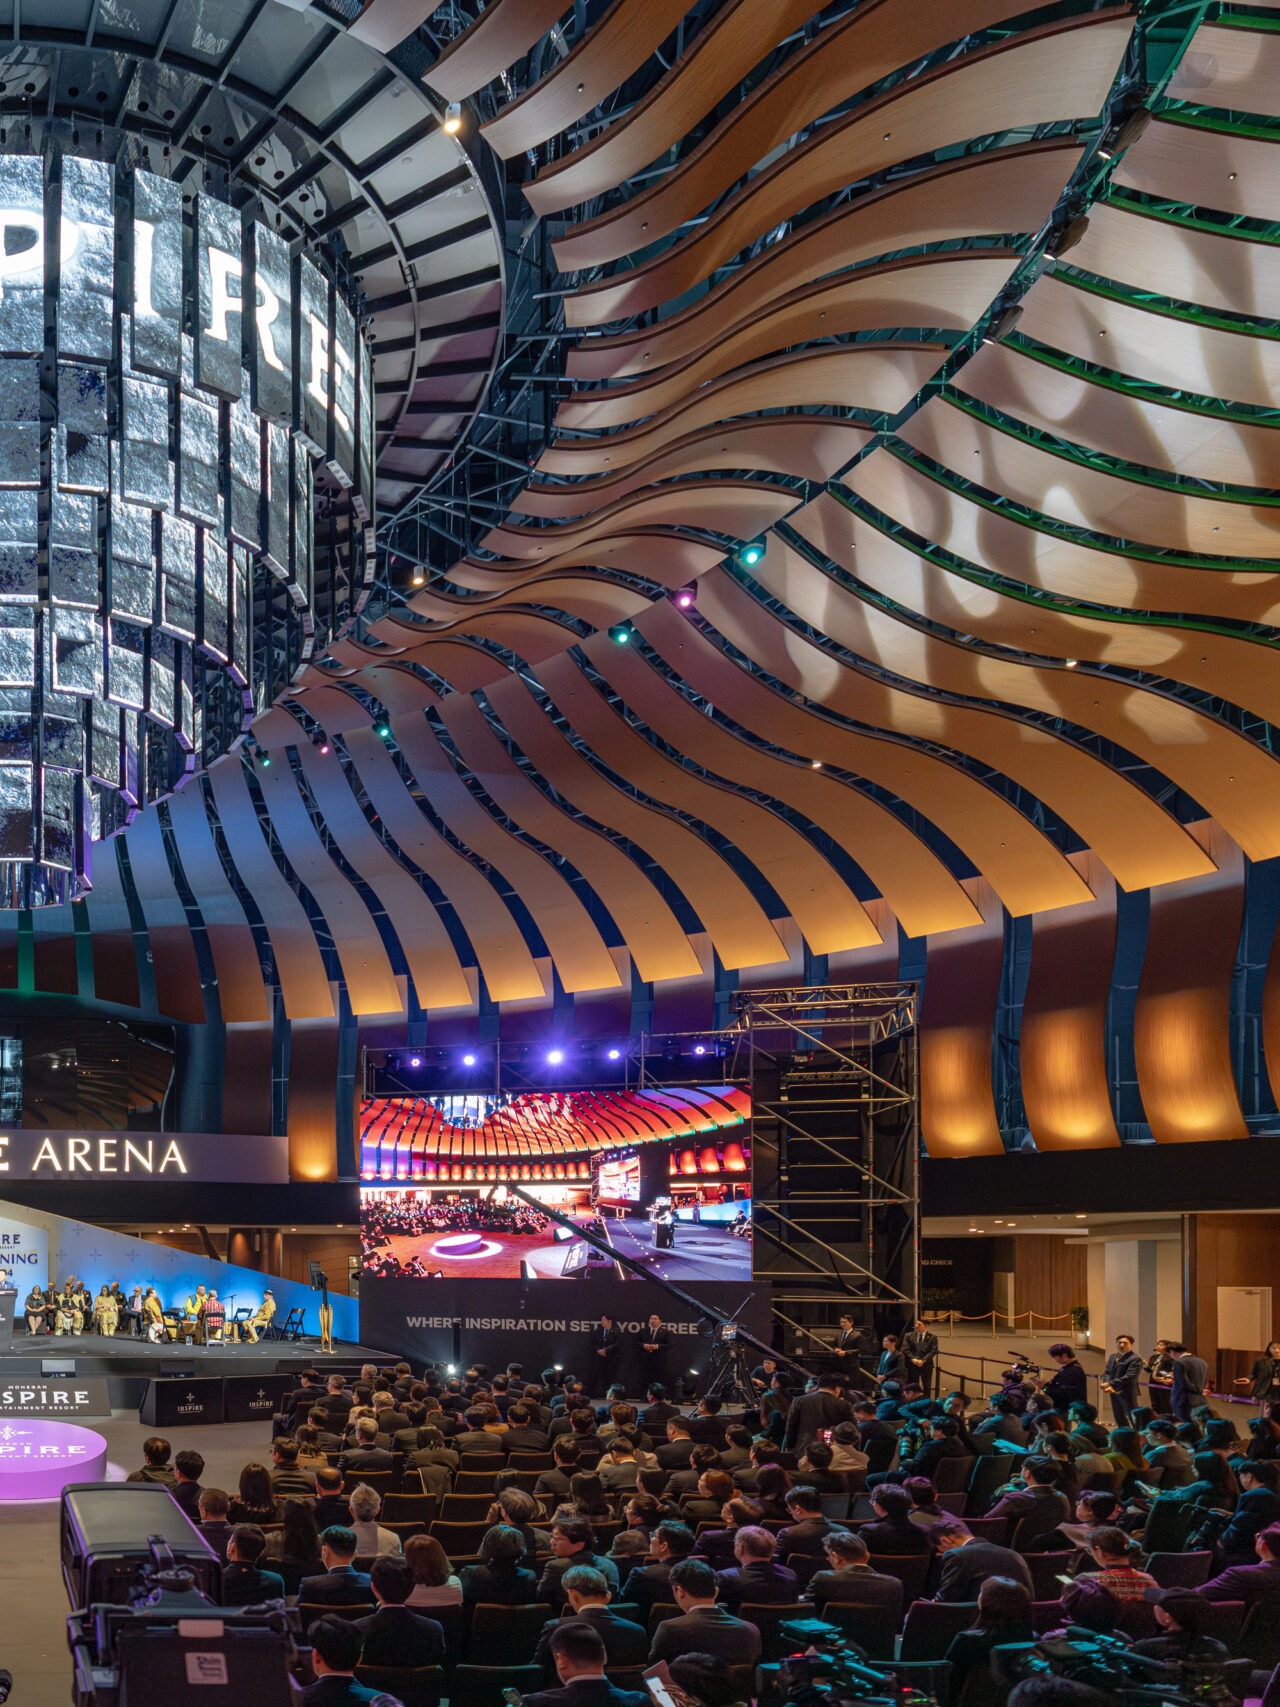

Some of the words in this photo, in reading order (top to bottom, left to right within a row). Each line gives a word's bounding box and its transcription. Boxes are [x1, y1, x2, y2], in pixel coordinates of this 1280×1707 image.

[31, 1137, 188, 1174] ARENA
[464, 1317, 566, 1332] INSPIRATION
[569, 1320, 602, 1333] SET
